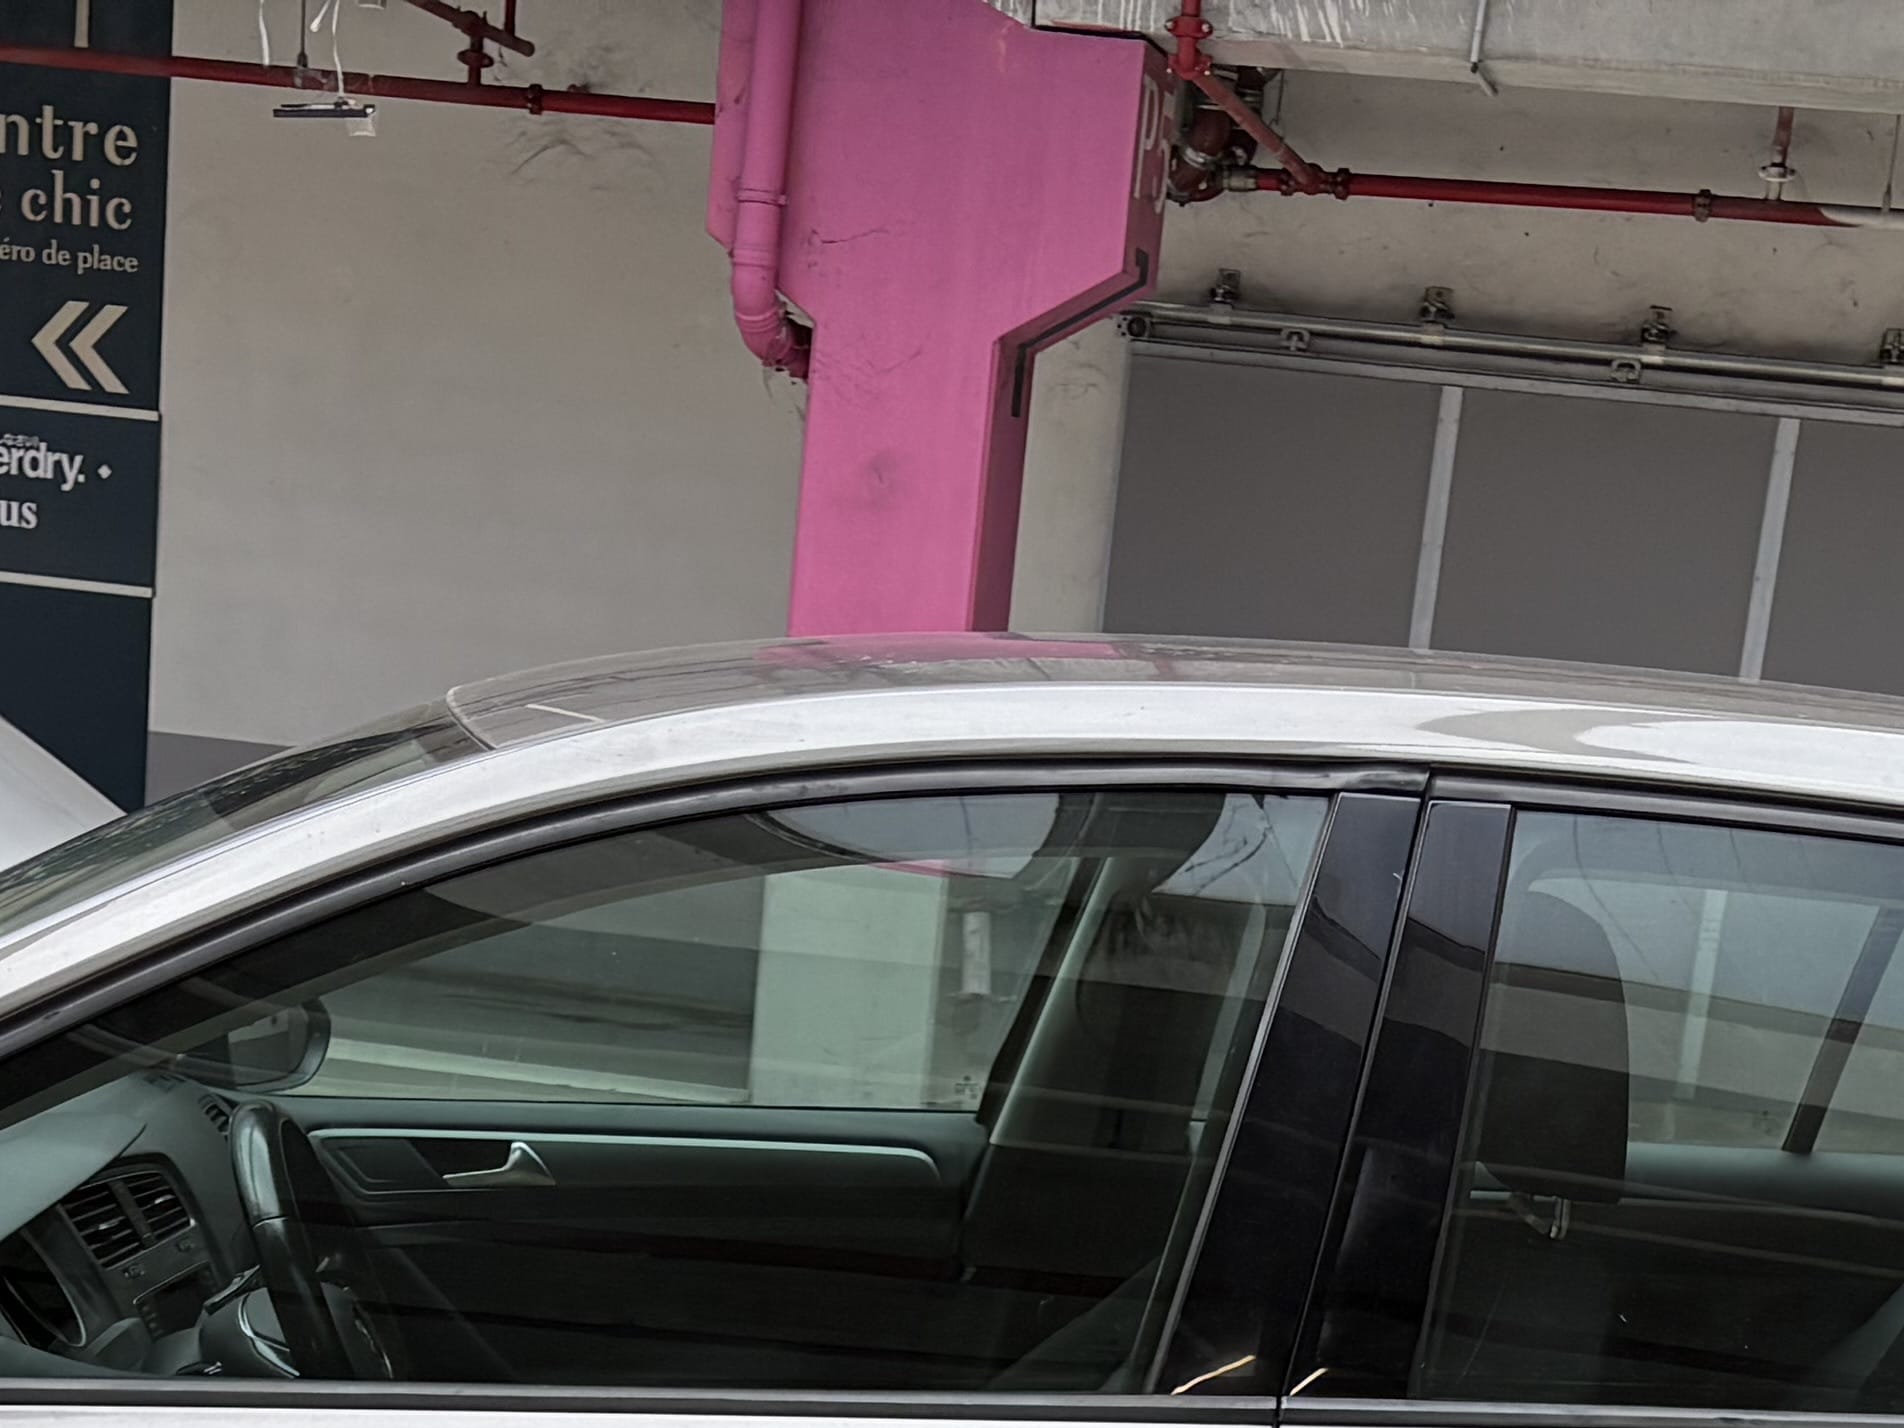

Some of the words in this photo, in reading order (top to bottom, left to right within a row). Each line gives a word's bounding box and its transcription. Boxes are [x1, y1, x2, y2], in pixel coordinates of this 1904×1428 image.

[20, 169, 133, 231] chic
[41, 240, 71, 267] de
[77, 243, 139, 275] place
